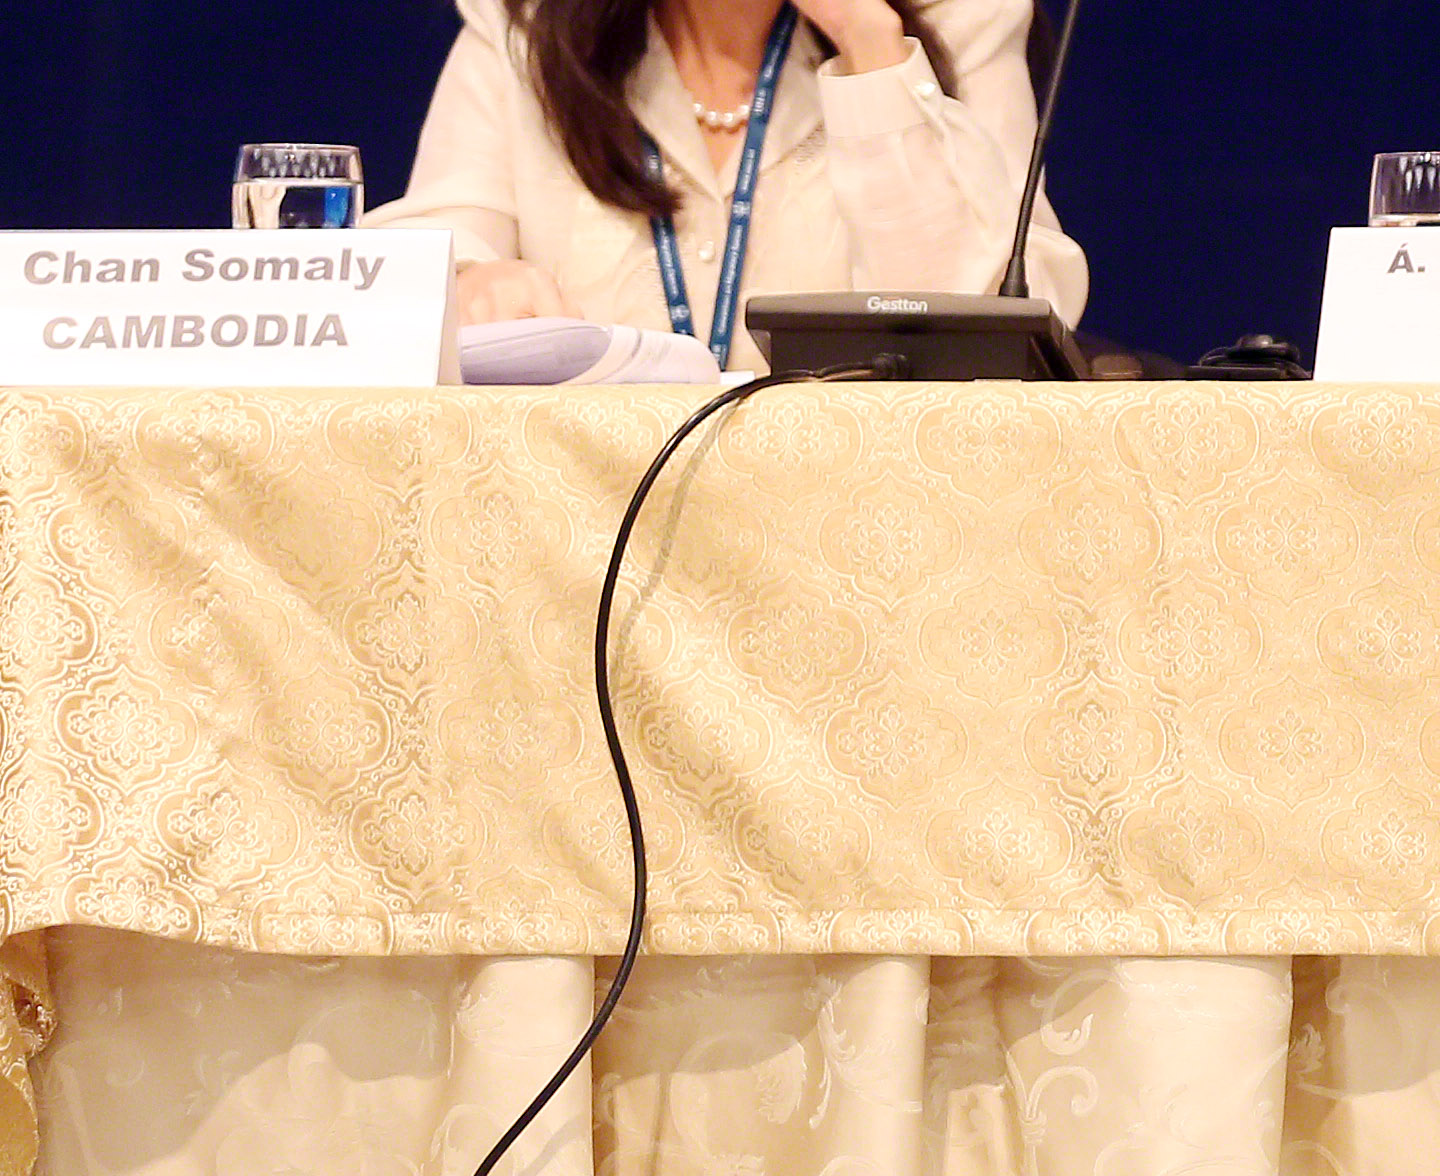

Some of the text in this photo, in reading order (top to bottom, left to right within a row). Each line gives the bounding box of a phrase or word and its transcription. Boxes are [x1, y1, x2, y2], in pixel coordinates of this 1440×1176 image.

[23, 247, 386, 292] Chan Somaly
[1387, 243, 1427, 274] Á.
[42, 313, 349, 351] CAMBODIA
